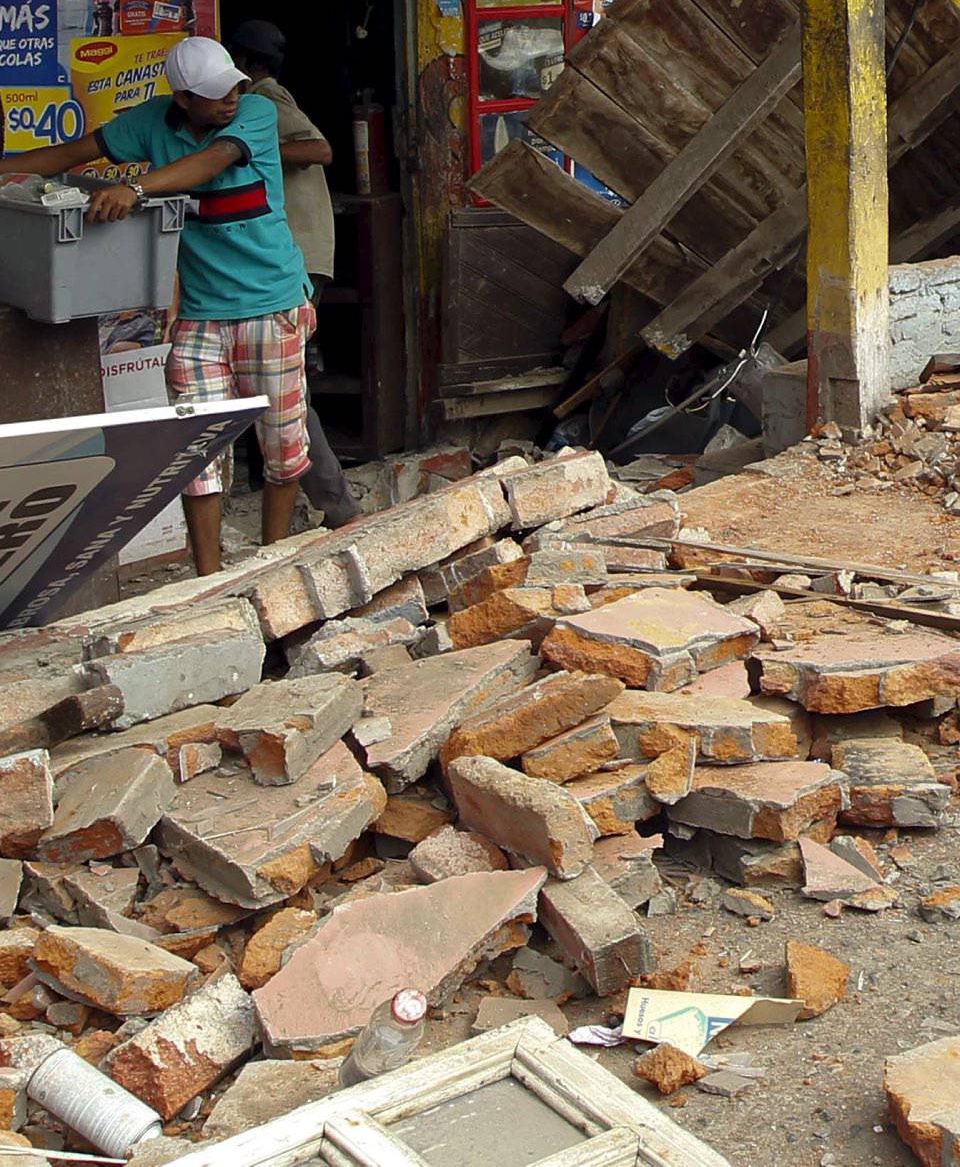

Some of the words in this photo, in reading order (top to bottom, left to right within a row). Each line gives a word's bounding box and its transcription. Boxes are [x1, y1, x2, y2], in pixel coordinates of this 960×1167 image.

[0, 0, 50, 33] MÁS
[19, 37, 54, 50] OTRAS
[80, 46, 113, 58] Maggi
[0, 52, 42, 66] COLAS
[115, 62, 166, 87] CANAST
[114, 88, 140, 104] PARA
[8, 101, 84, 145] $0.40
[99, 357, 167, 377] DISFRÚTAL
[637, 997, 649, 1027] Huesos
